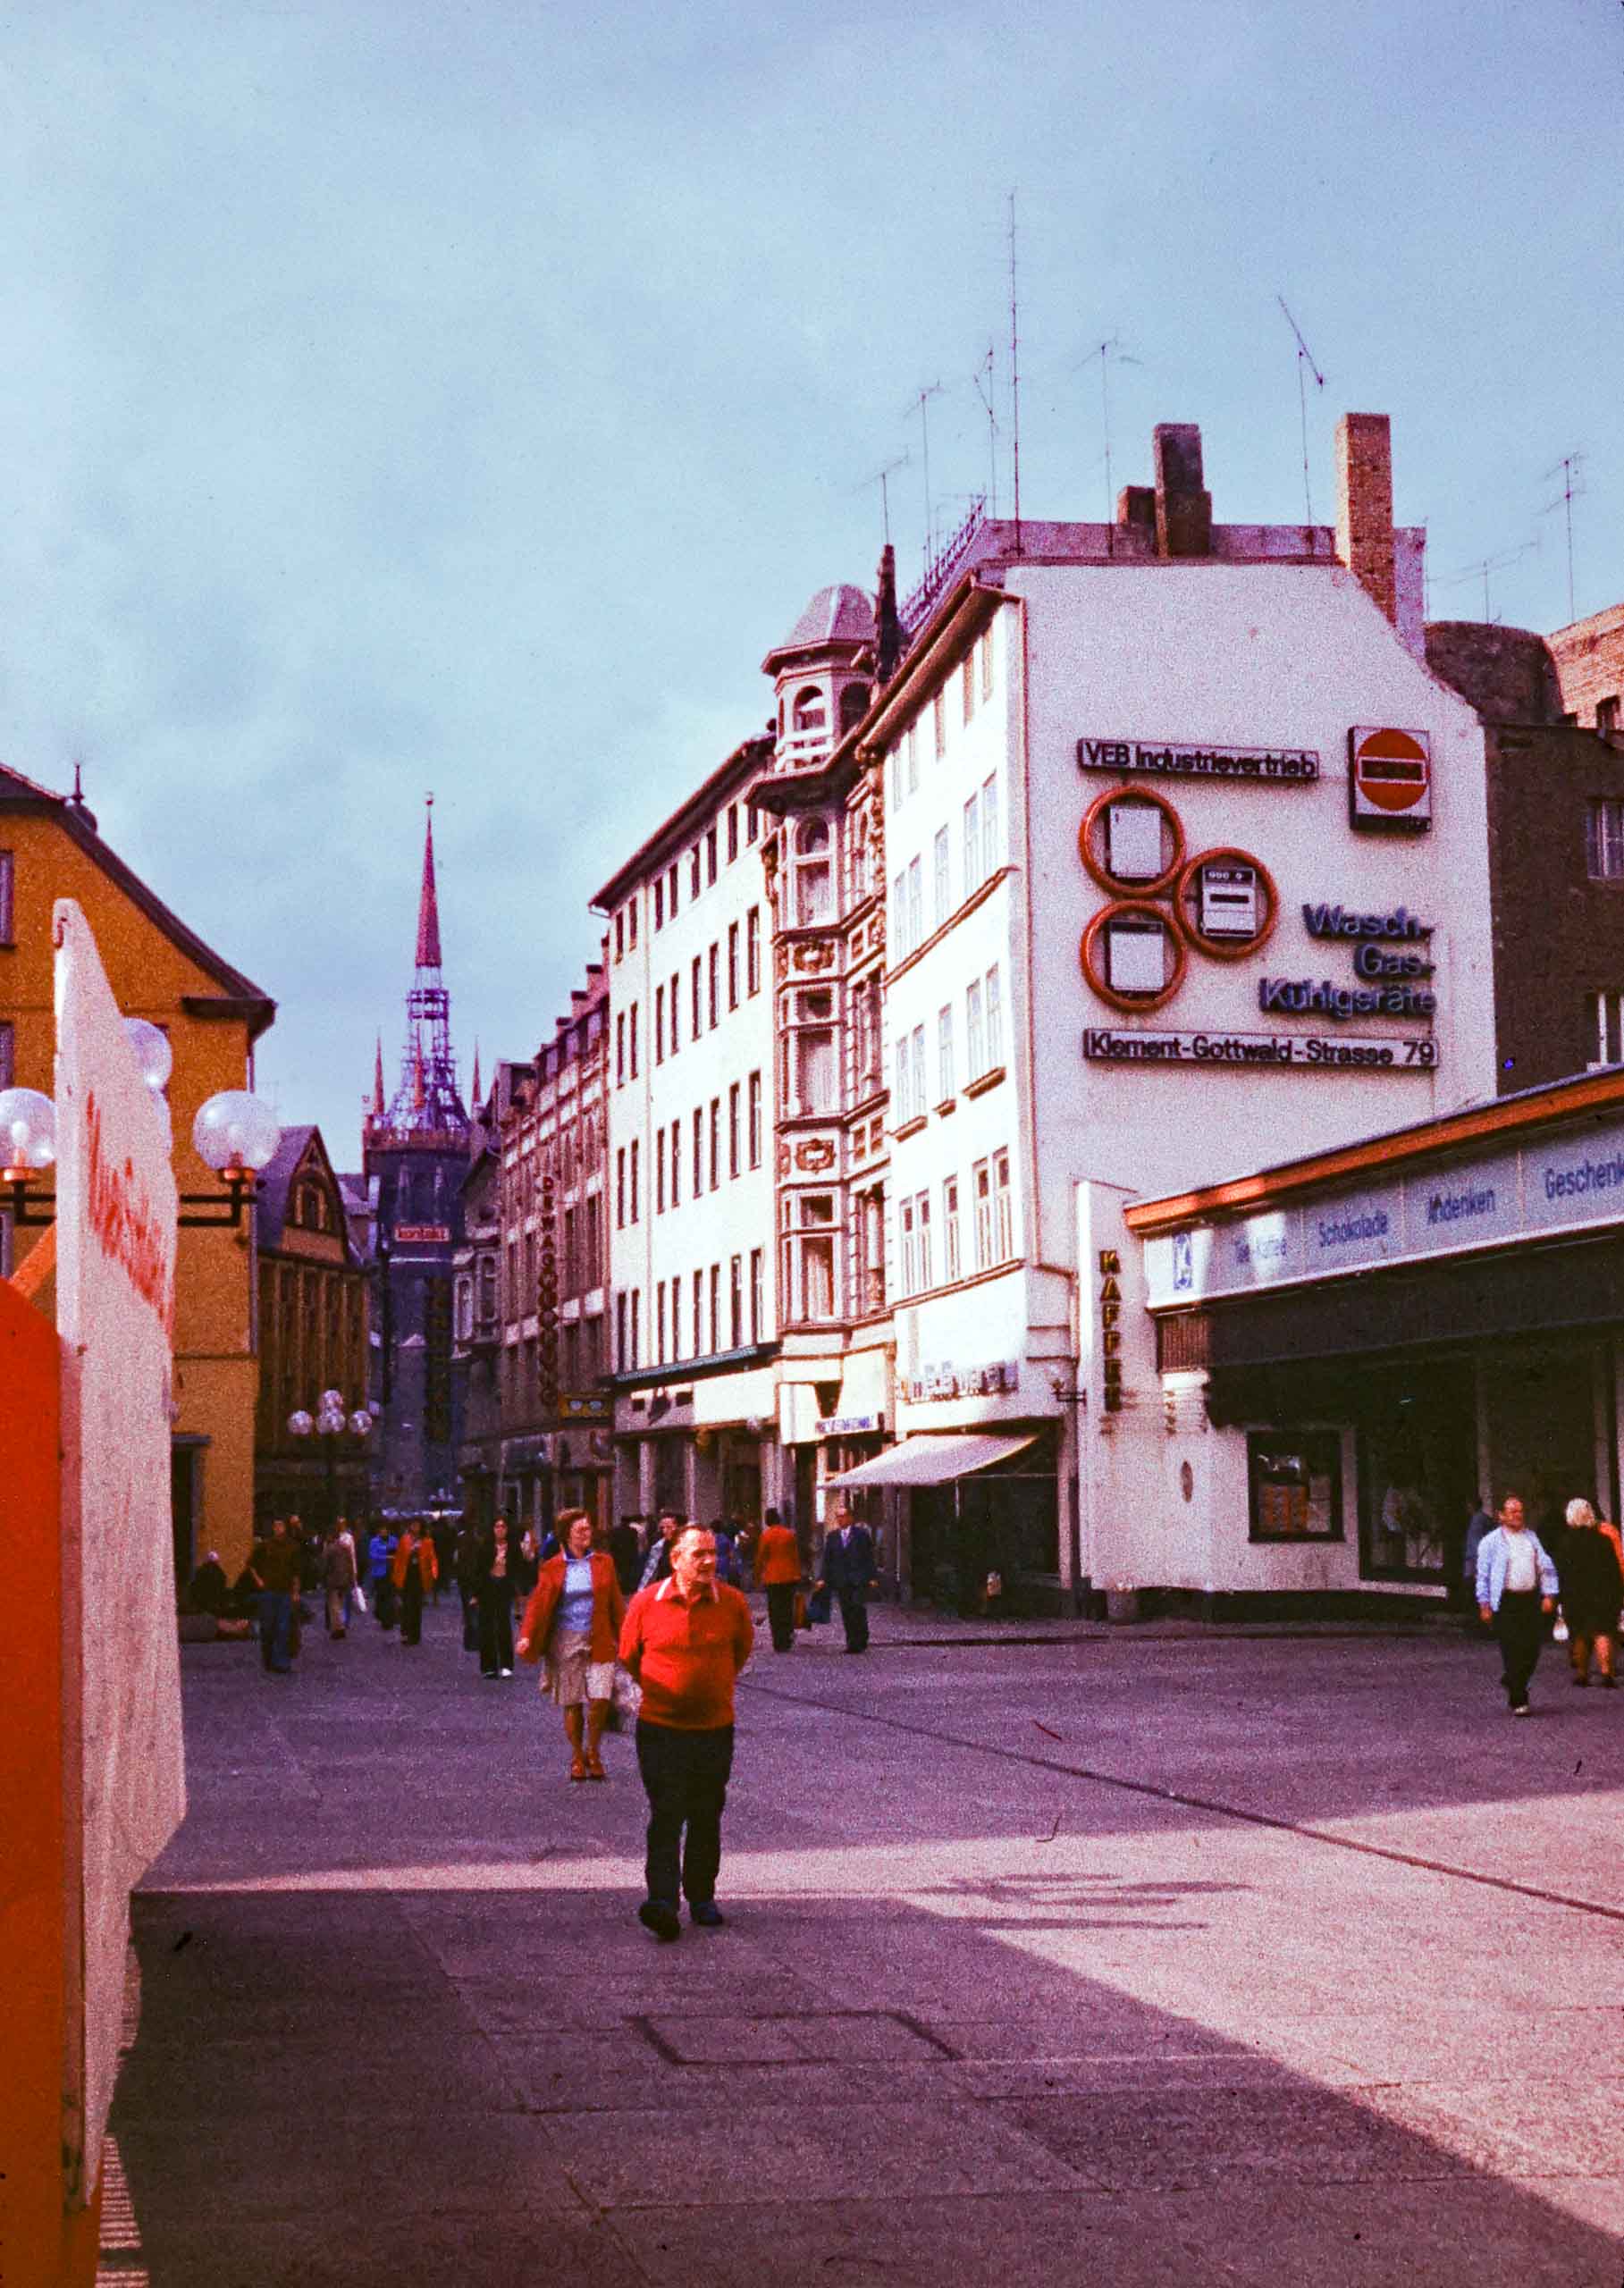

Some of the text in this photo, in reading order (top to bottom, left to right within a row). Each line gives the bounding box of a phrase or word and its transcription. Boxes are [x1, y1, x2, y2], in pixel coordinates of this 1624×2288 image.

[1085, 742, 1316, 777] VEB Industrievertrieb
[1302, 904, 1435, 938] Wasch-
[1355, 944, 1435, 977] Gas-
[1259, 978, 1436, 1018] Kühlgeräte
[1402, 1041, 1434, 1064] 79
[1428, 1189, 1496, 1224] Andenken
[1318, 1210, 1389, 1249] Schokolade
[1099, 1249, 1122, 1412] KAFFEE
